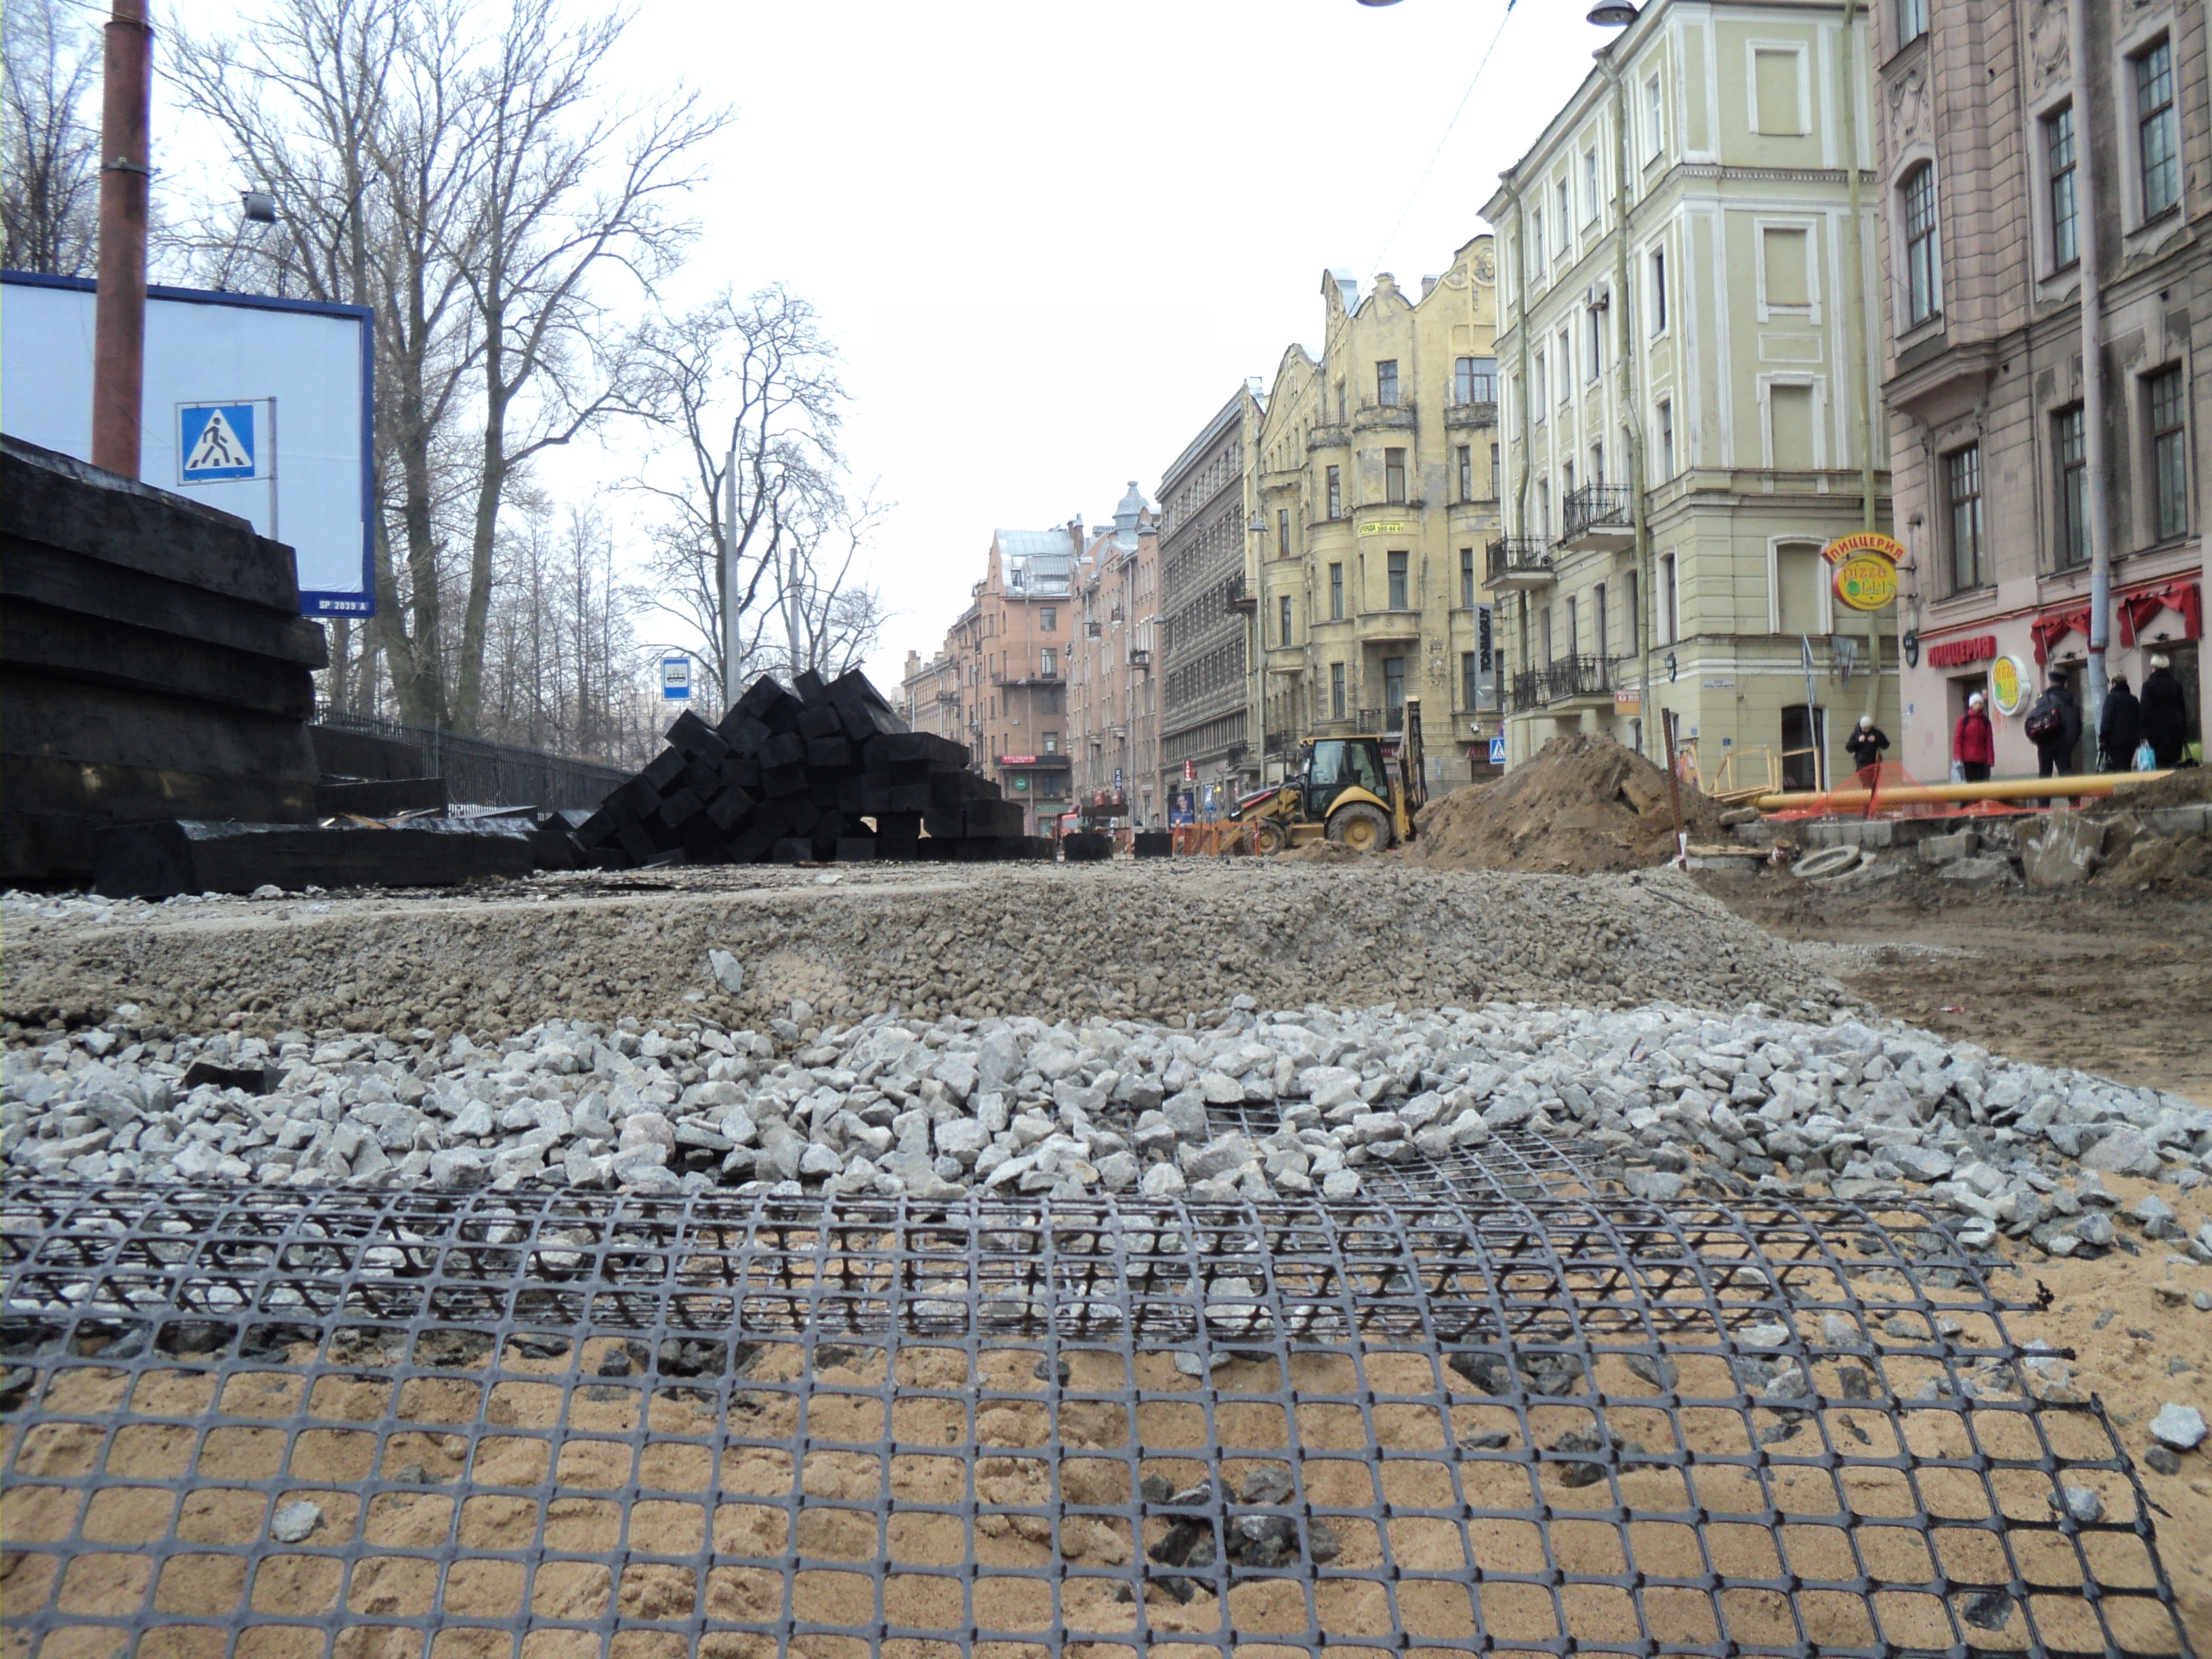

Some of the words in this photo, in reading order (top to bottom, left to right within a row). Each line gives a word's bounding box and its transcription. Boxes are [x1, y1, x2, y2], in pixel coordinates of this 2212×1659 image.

[1830, 536, 1904, 560] ПИЦЦЕРИЯ
[1843, 568, 1887, 584] pizza
[319, 600, 330, 609] SP
[335, 602, 356, 610] 2039
[1927, 636, 1991, 667] ПИЦЦЕРИЯ
